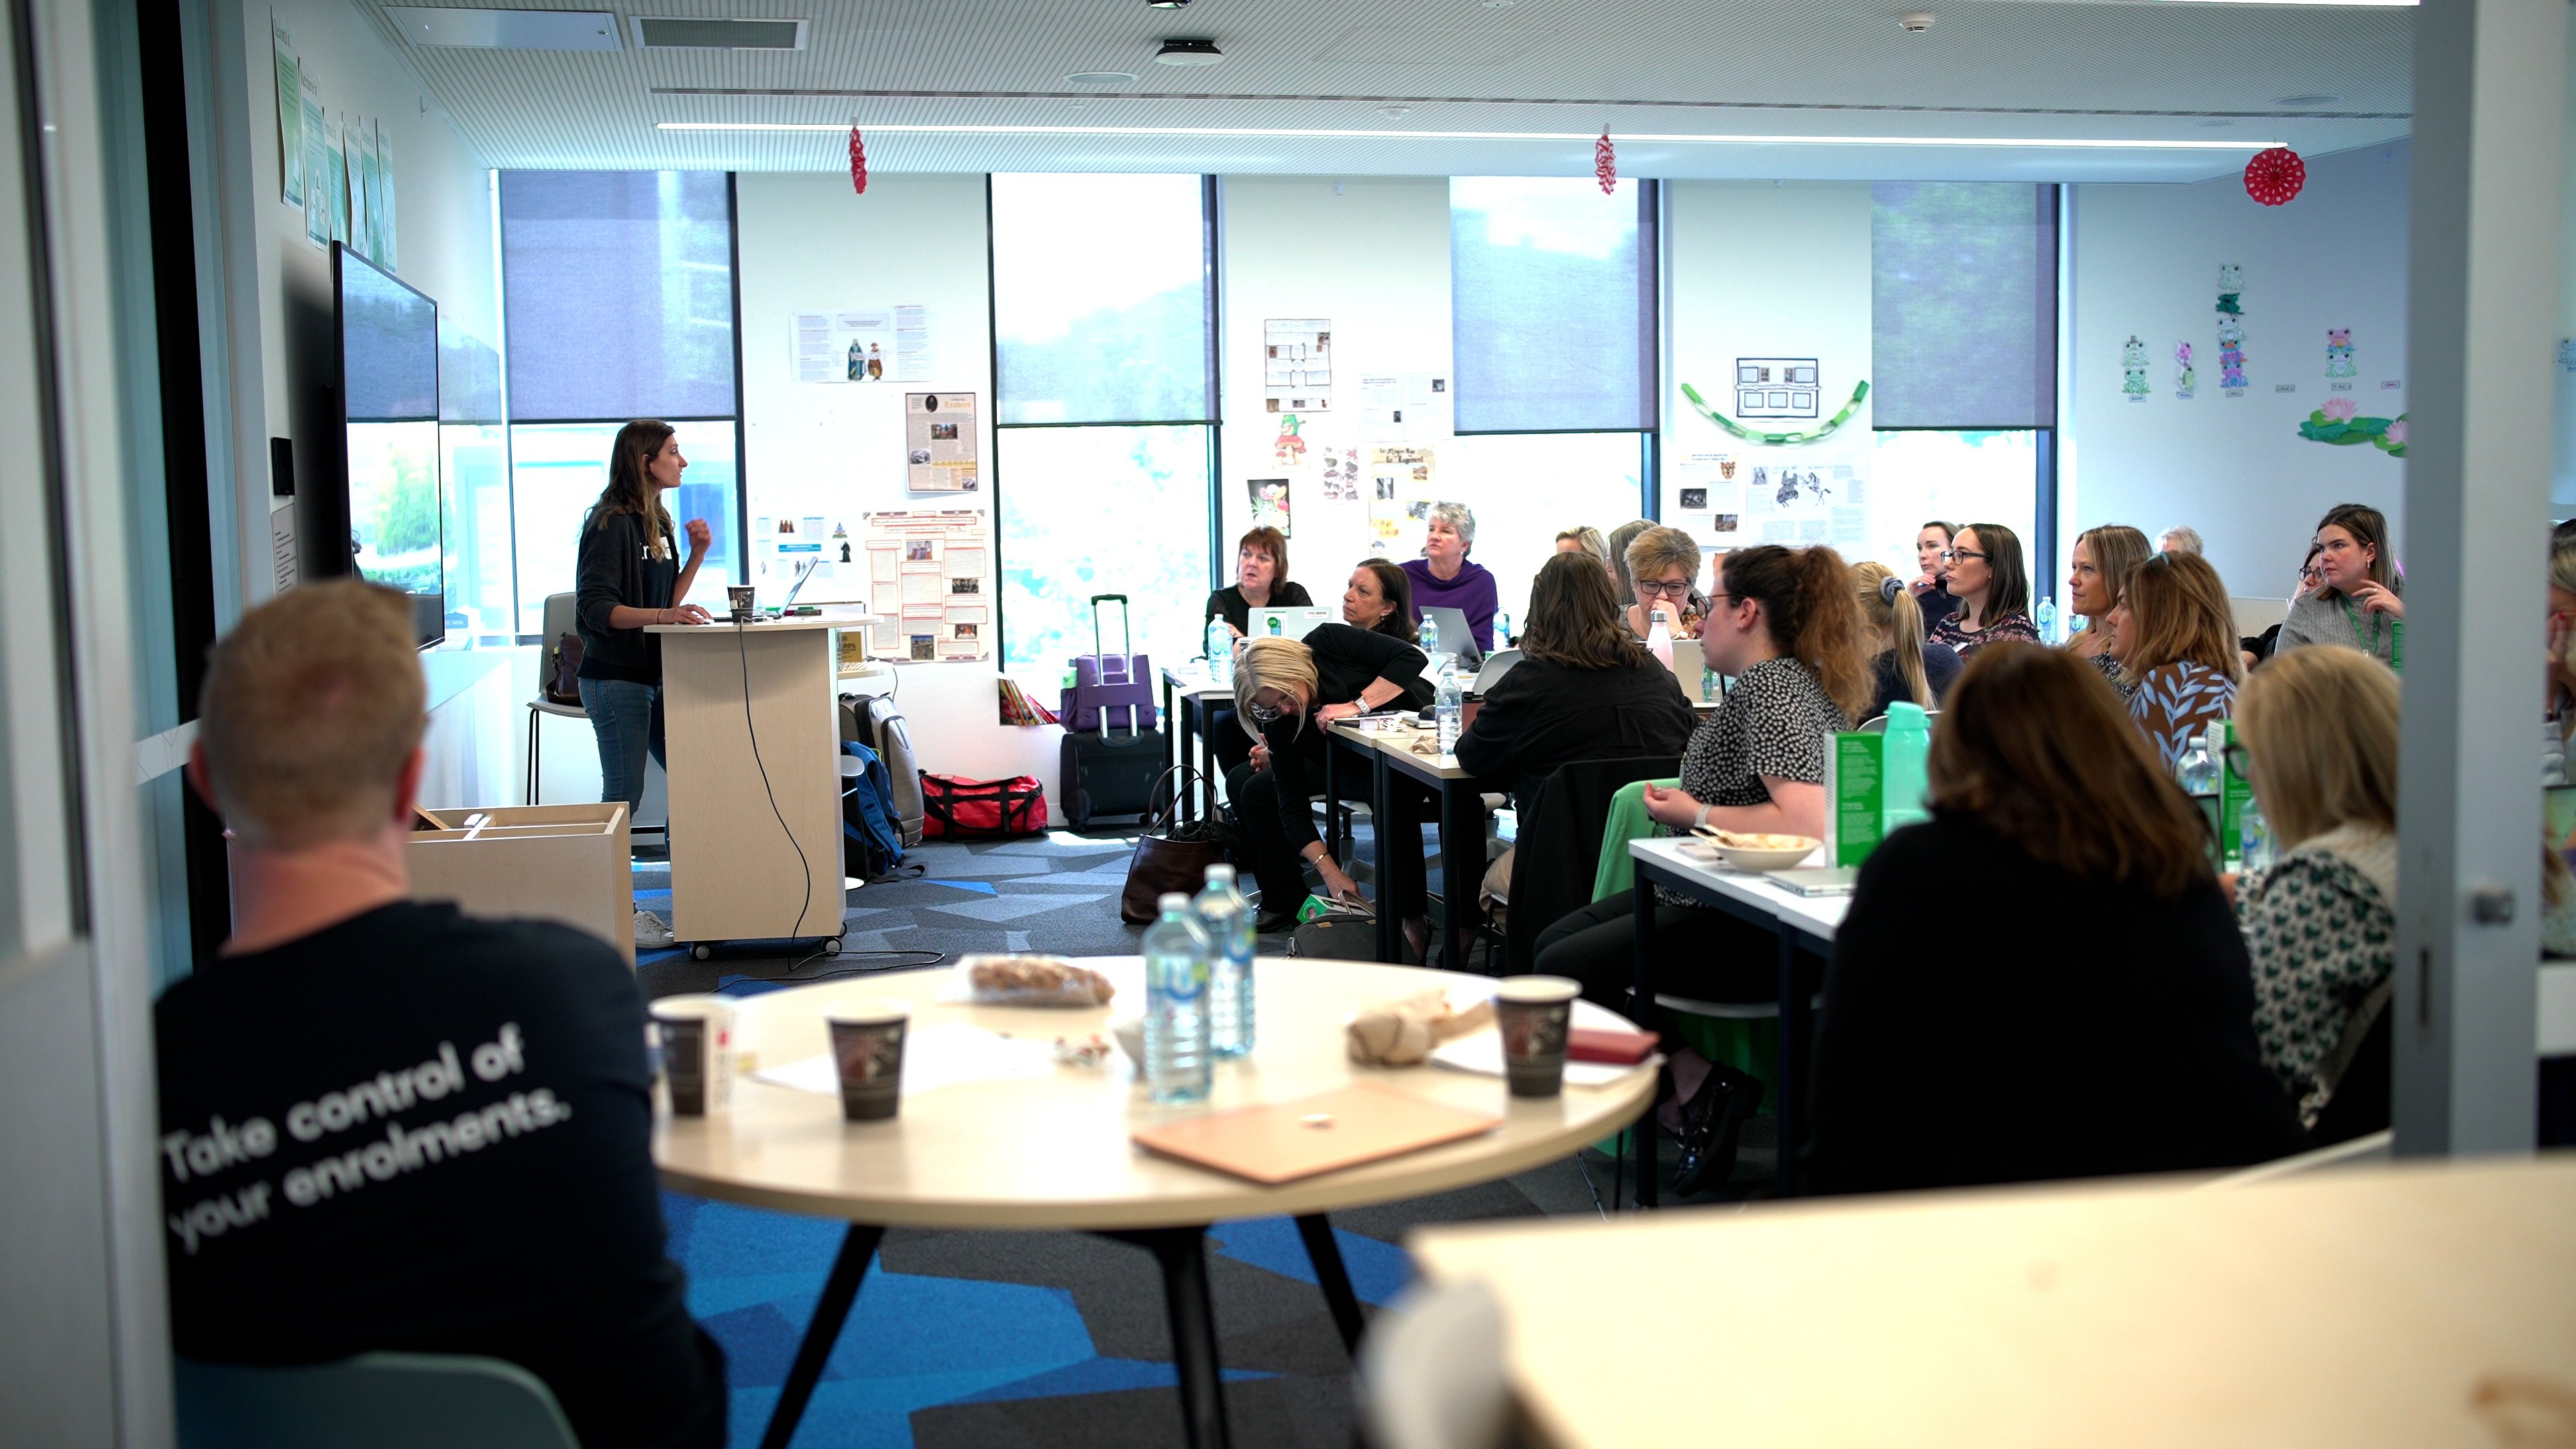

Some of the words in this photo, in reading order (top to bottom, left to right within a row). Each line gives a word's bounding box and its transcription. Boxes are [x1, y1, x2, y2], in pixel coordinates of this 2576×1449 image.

[163, 1114, 278, 1182] Take
[286, 1040, 466, 1142] control
[471, 1021, 525, 1082] of
[168, 1181, 271, 1256] your
[282, 1087, 573, 1207] enrolments.
